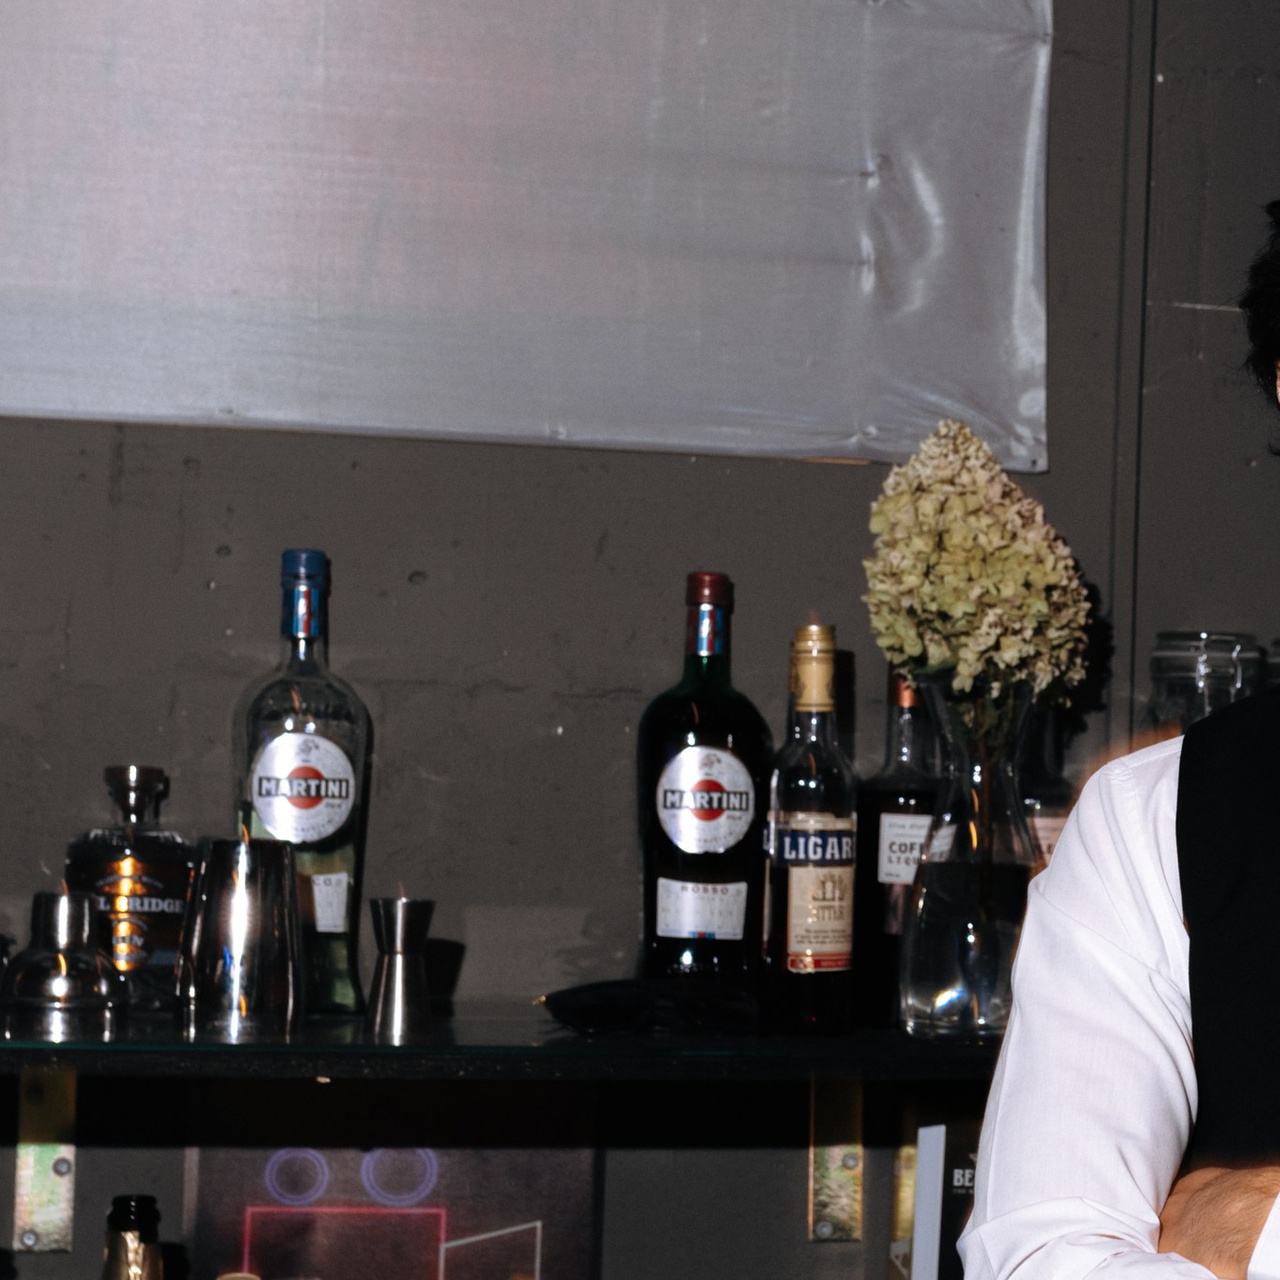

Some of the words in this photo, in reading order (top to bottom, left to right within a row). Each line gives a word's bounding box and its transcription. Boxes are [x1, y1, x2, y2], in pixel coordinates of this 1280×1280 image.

[260, 778, 348, 798] MARTINI
[664, 791, 748, 810] MARTINI
[783, 835, 857, 861] LIGAR
